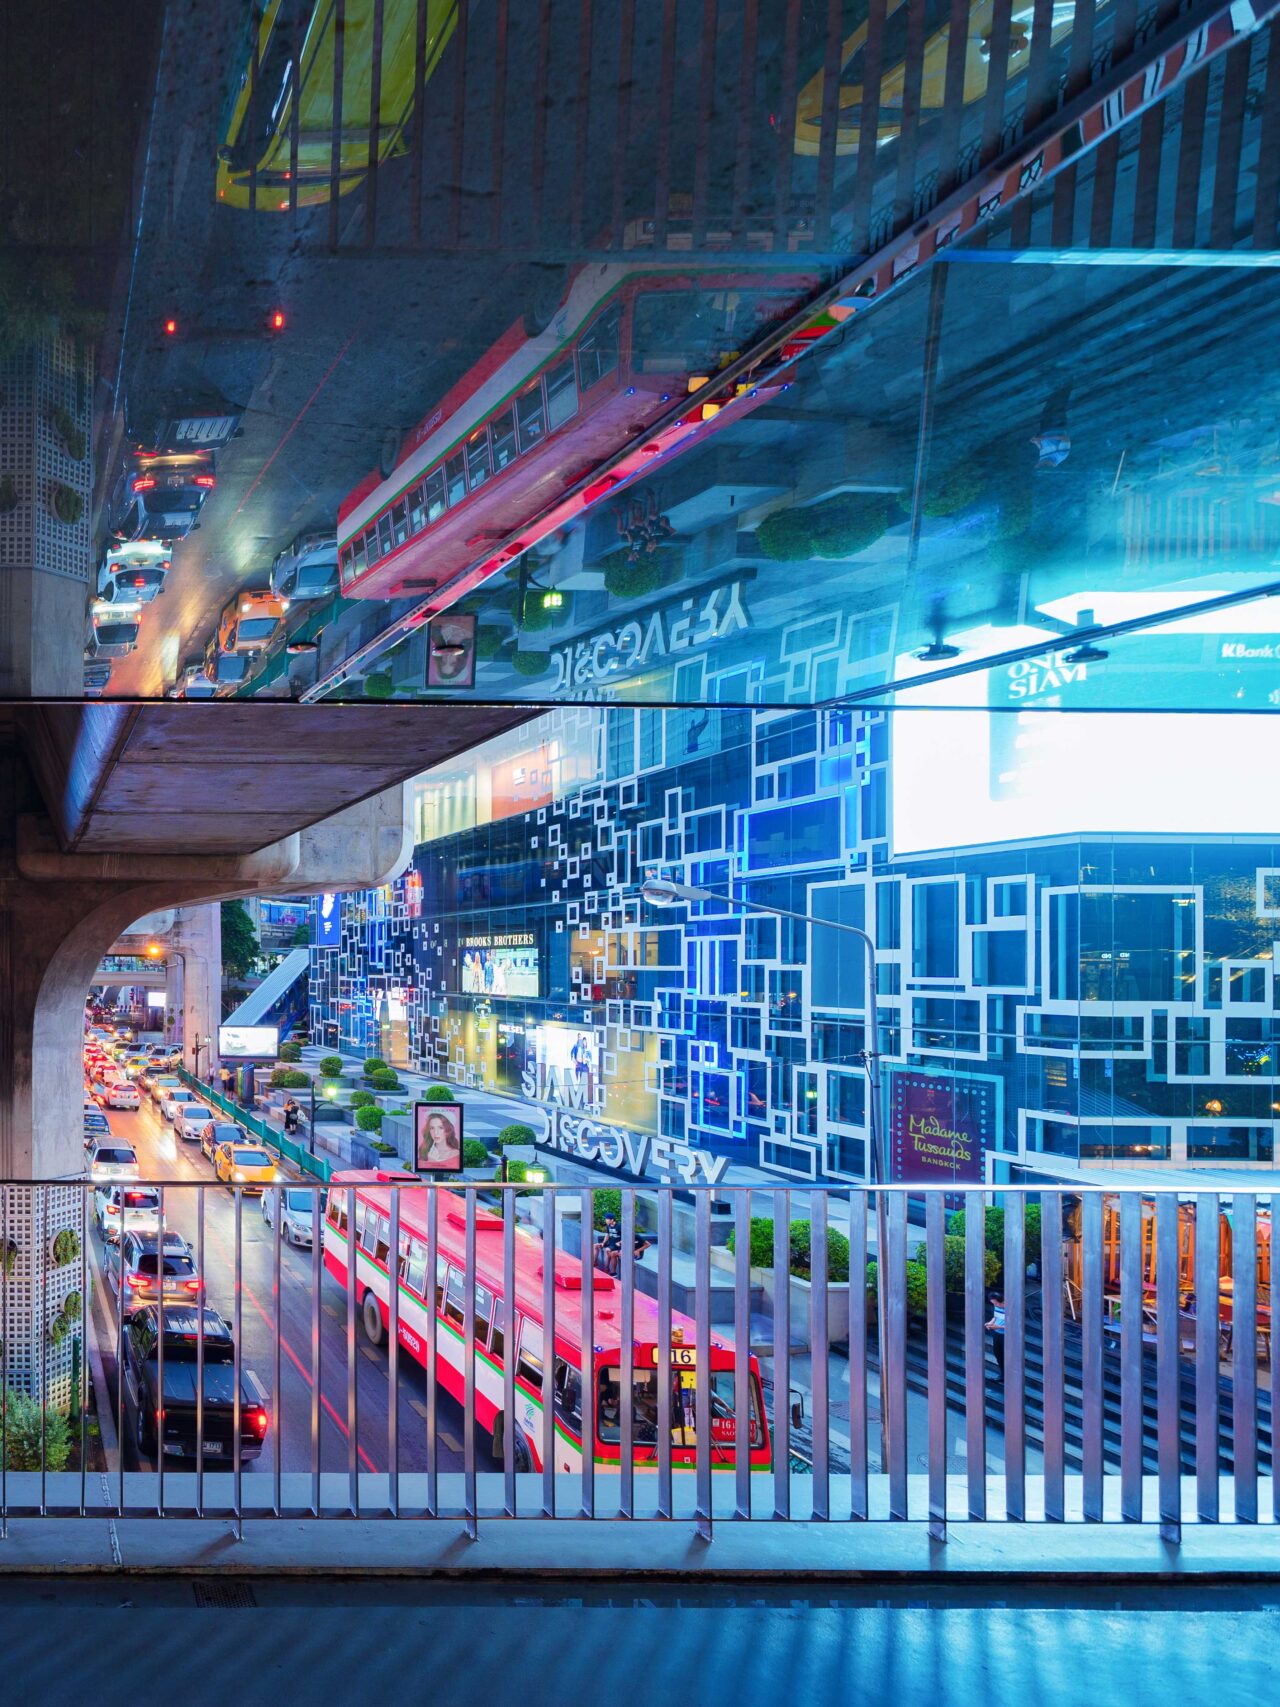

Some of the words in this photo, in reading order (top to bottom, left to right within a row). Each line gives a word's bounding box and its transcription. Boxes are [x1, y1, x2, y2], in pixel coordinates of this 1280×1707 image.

[465, 936, 492, 948] BROOKS
[494, 933, 534, 947] BROTHERS
[521, 1060, 592, 1111] SIAM
[909, 1114, 972, 1142] Madame
[535, 1106, 732, 1199] DISCOVERY
[909, 1133, 971, 1160] Tussauds
[921, 1155, 961, 1170] BANGKOK
[671, 1349, 692, 1364] 16
